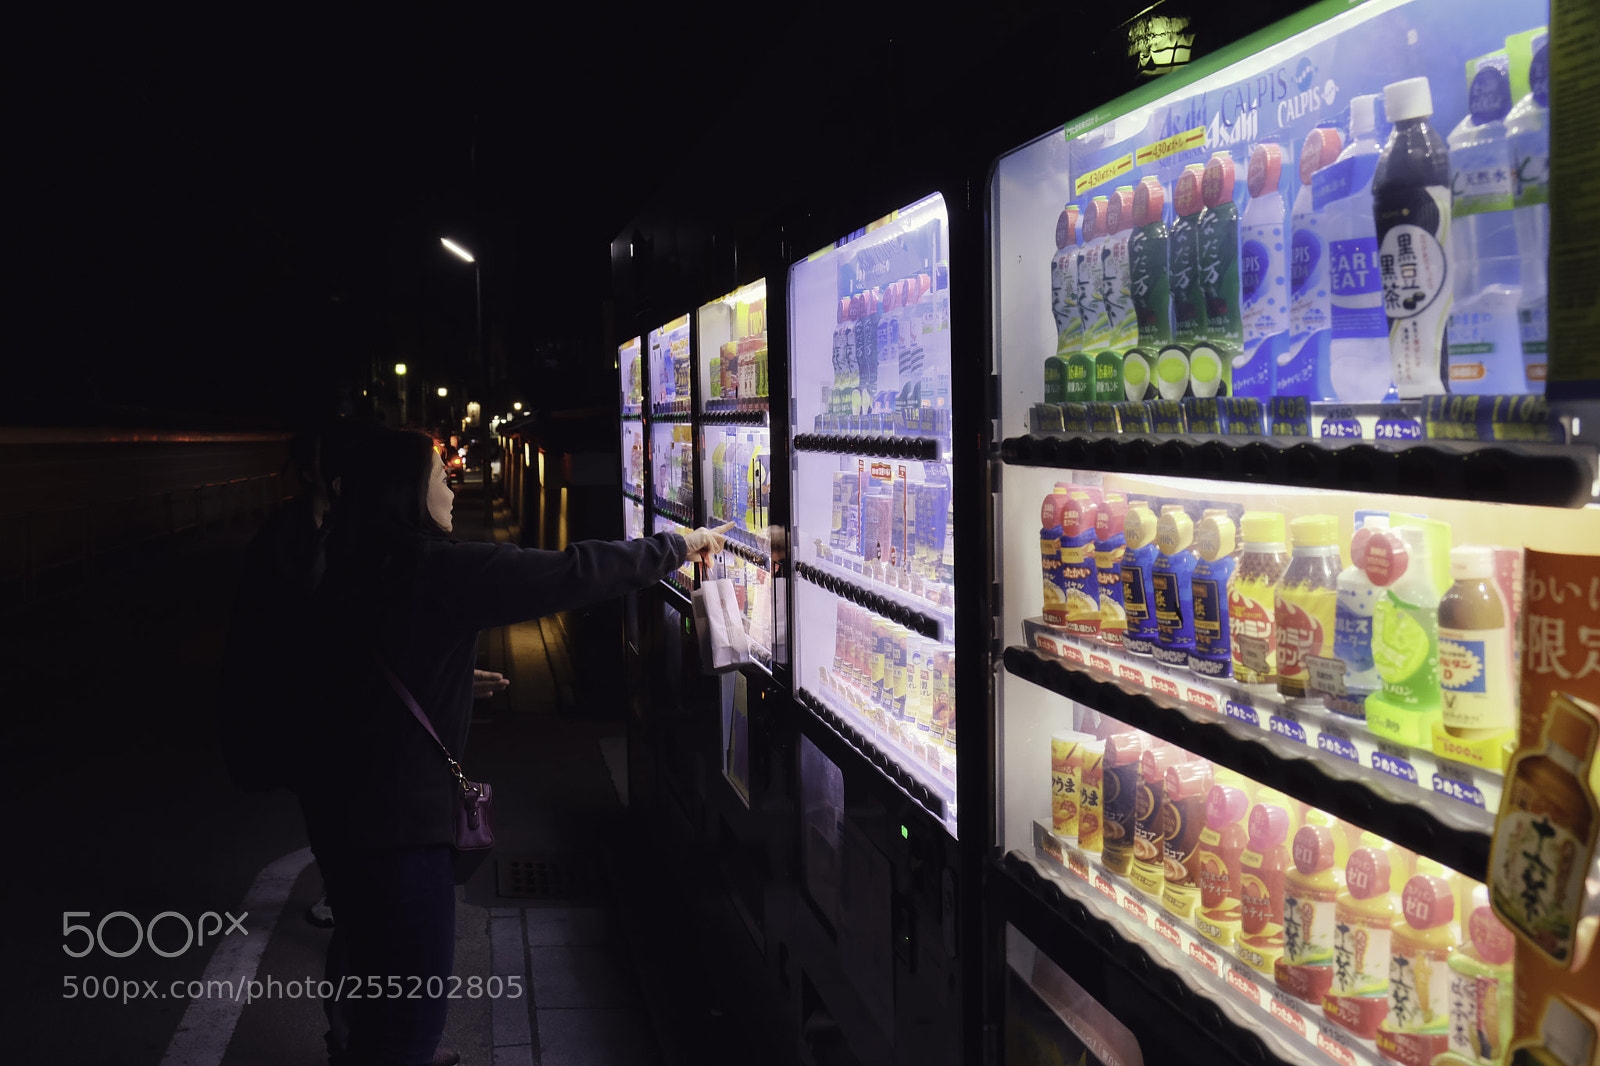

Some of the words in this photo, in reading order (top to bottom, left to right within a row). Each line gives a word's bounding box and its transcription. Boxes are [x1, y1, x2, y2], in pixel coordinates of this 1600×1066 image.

[1221, 67, 1287, 128] CALPIS
[1277, 86, 1321, 128] CALPIS
[1205, 98, 1259, 150] Asahi
